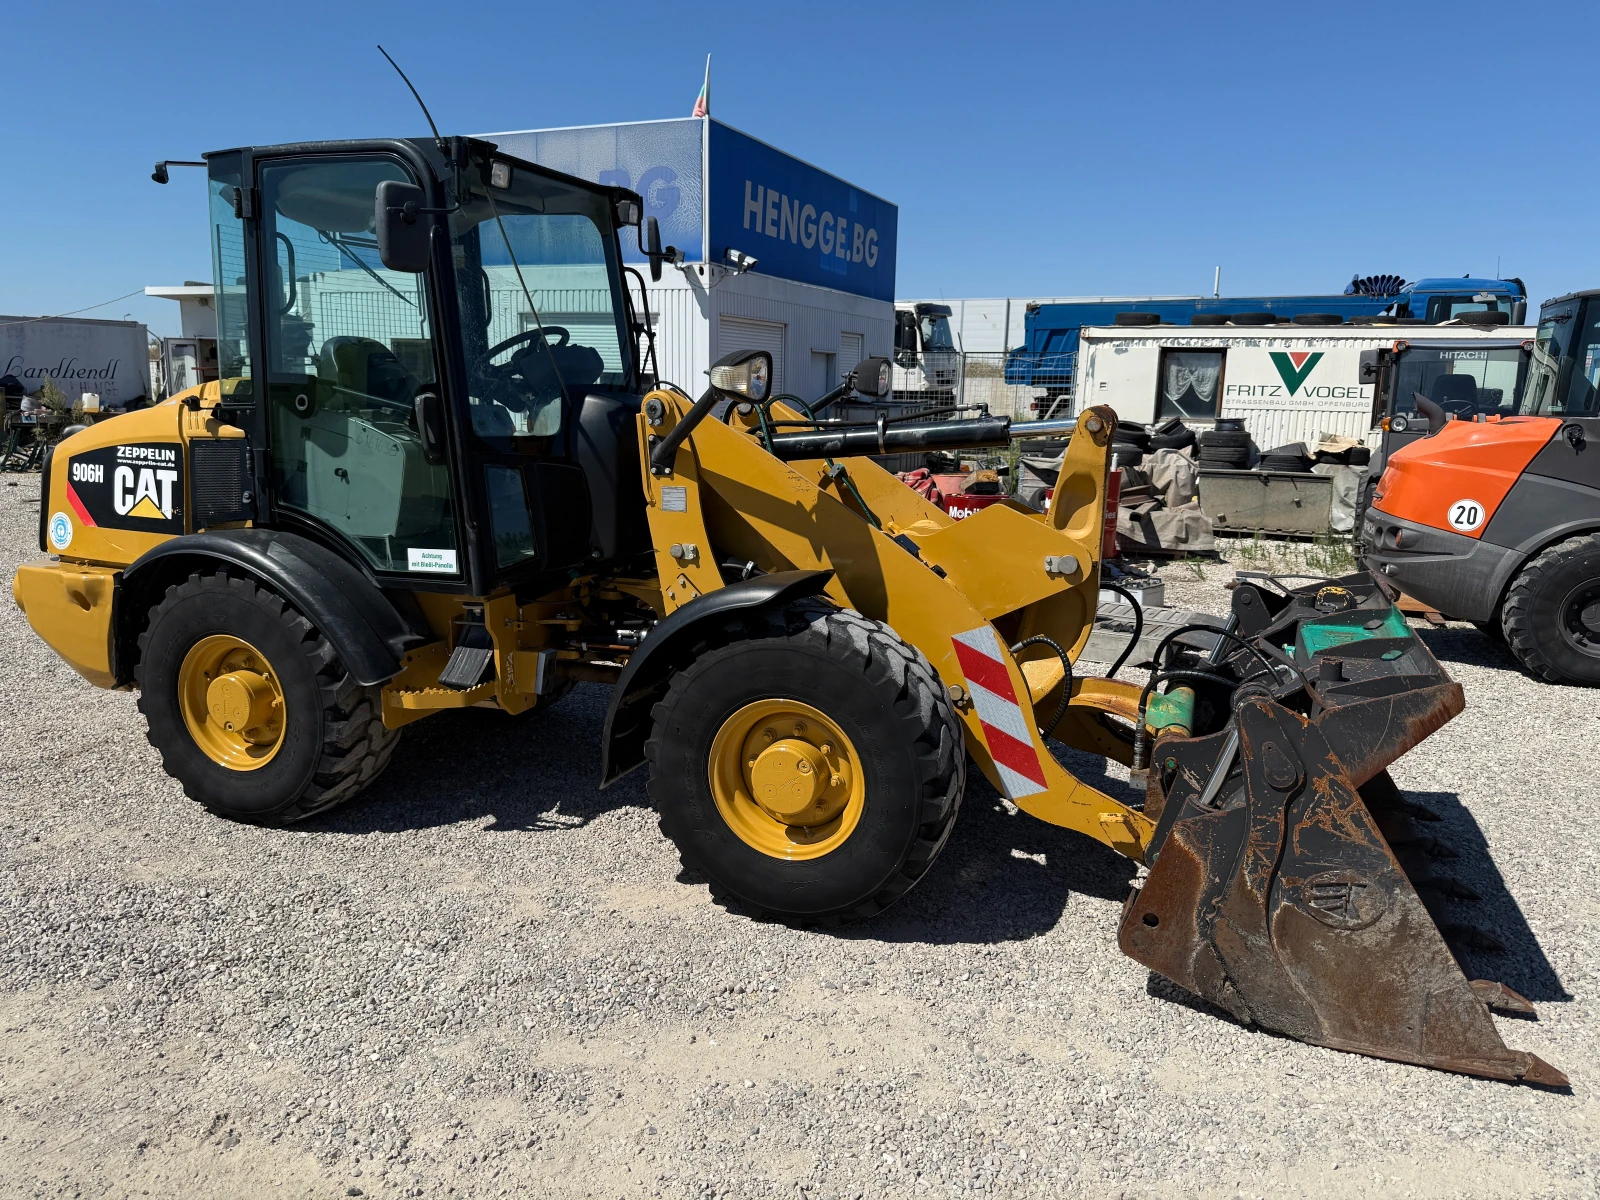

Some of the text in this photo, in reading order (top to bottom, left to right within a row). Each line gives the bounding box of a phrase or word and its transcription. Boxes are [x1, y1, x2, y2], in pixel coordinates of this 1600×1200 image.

[743, 180, 879, 268] HENGGE.BG
[1439, 351, 1488, 360] HITACHI
[2, 355, 122, 380] Landhendl
[1226, 384, 1371, 399] FRITZ VOGEL
[116, 446, 176, 461] ZEPPELIN
[72, 462, 104, 483] 906H
[114, 465, 178, 520] CAT
[1454, 505, 1478, 526] 20
[421, 552, 443, 561] Achtung
